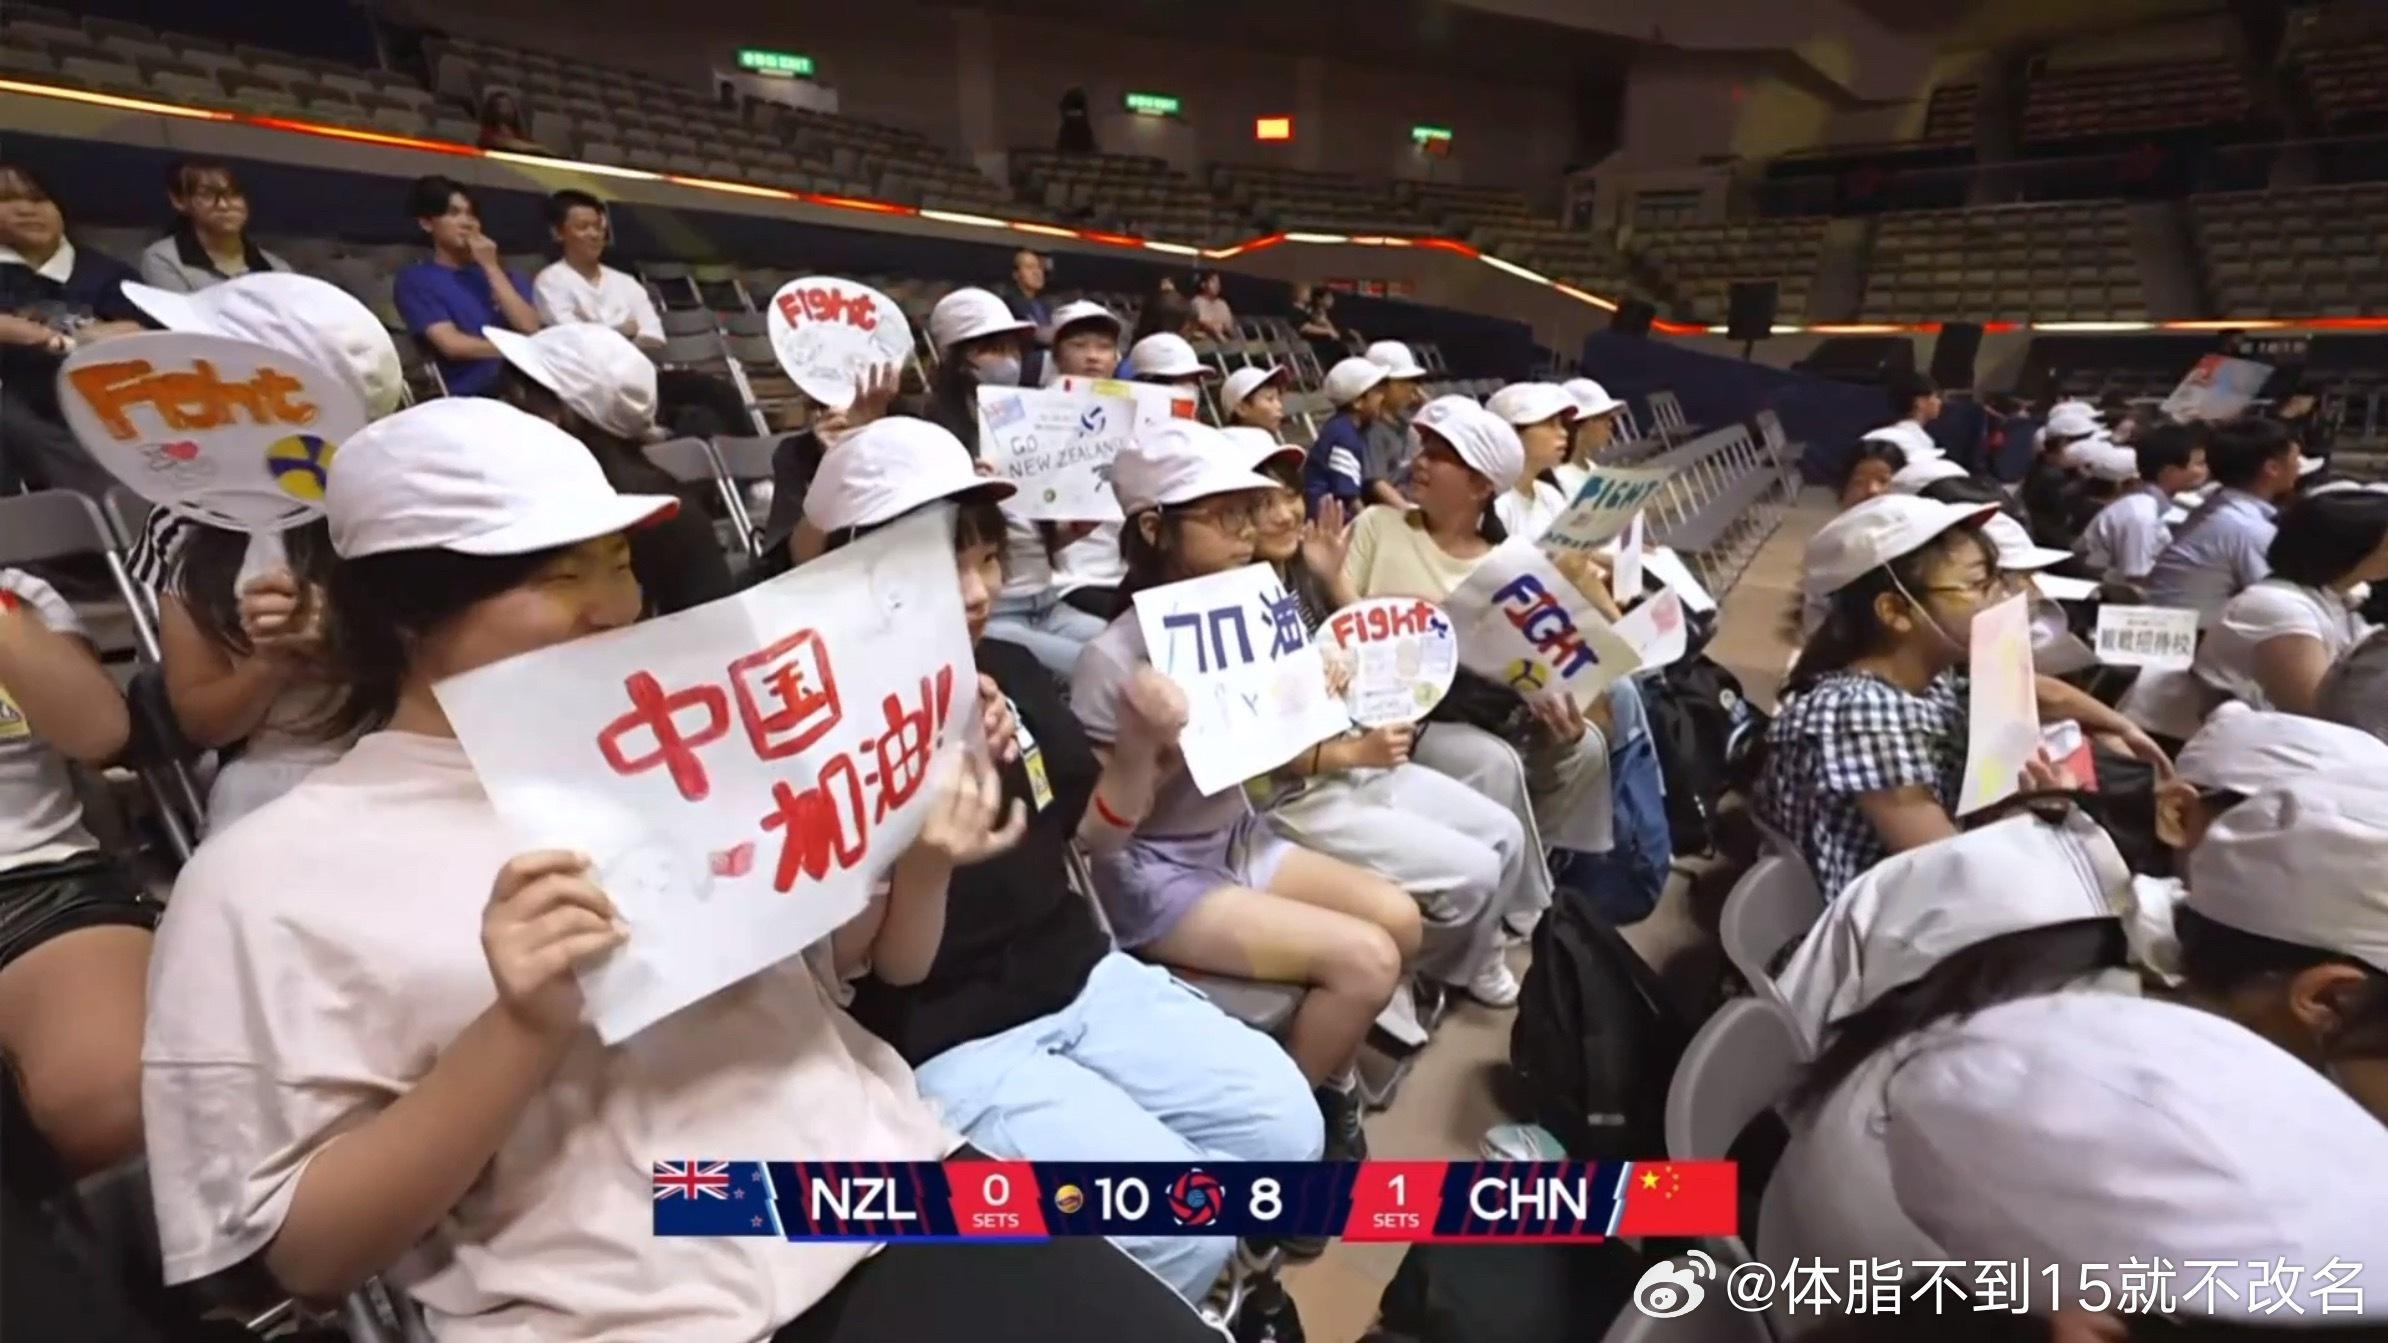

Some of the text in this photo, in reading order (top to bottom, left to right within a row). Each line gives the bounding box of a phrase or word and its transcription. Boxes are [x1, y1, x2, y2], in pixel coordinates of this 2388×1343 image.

[776, 287, 877, 331] Fight
[1008, 454, 1050, 480] NEW
[1010, 434, 1039, 457] GO
[1330, 601, 1435, 650] Fight
[1490, 572, 1600, 679] FIGHT
[597, 628, 843, 801] 中国
